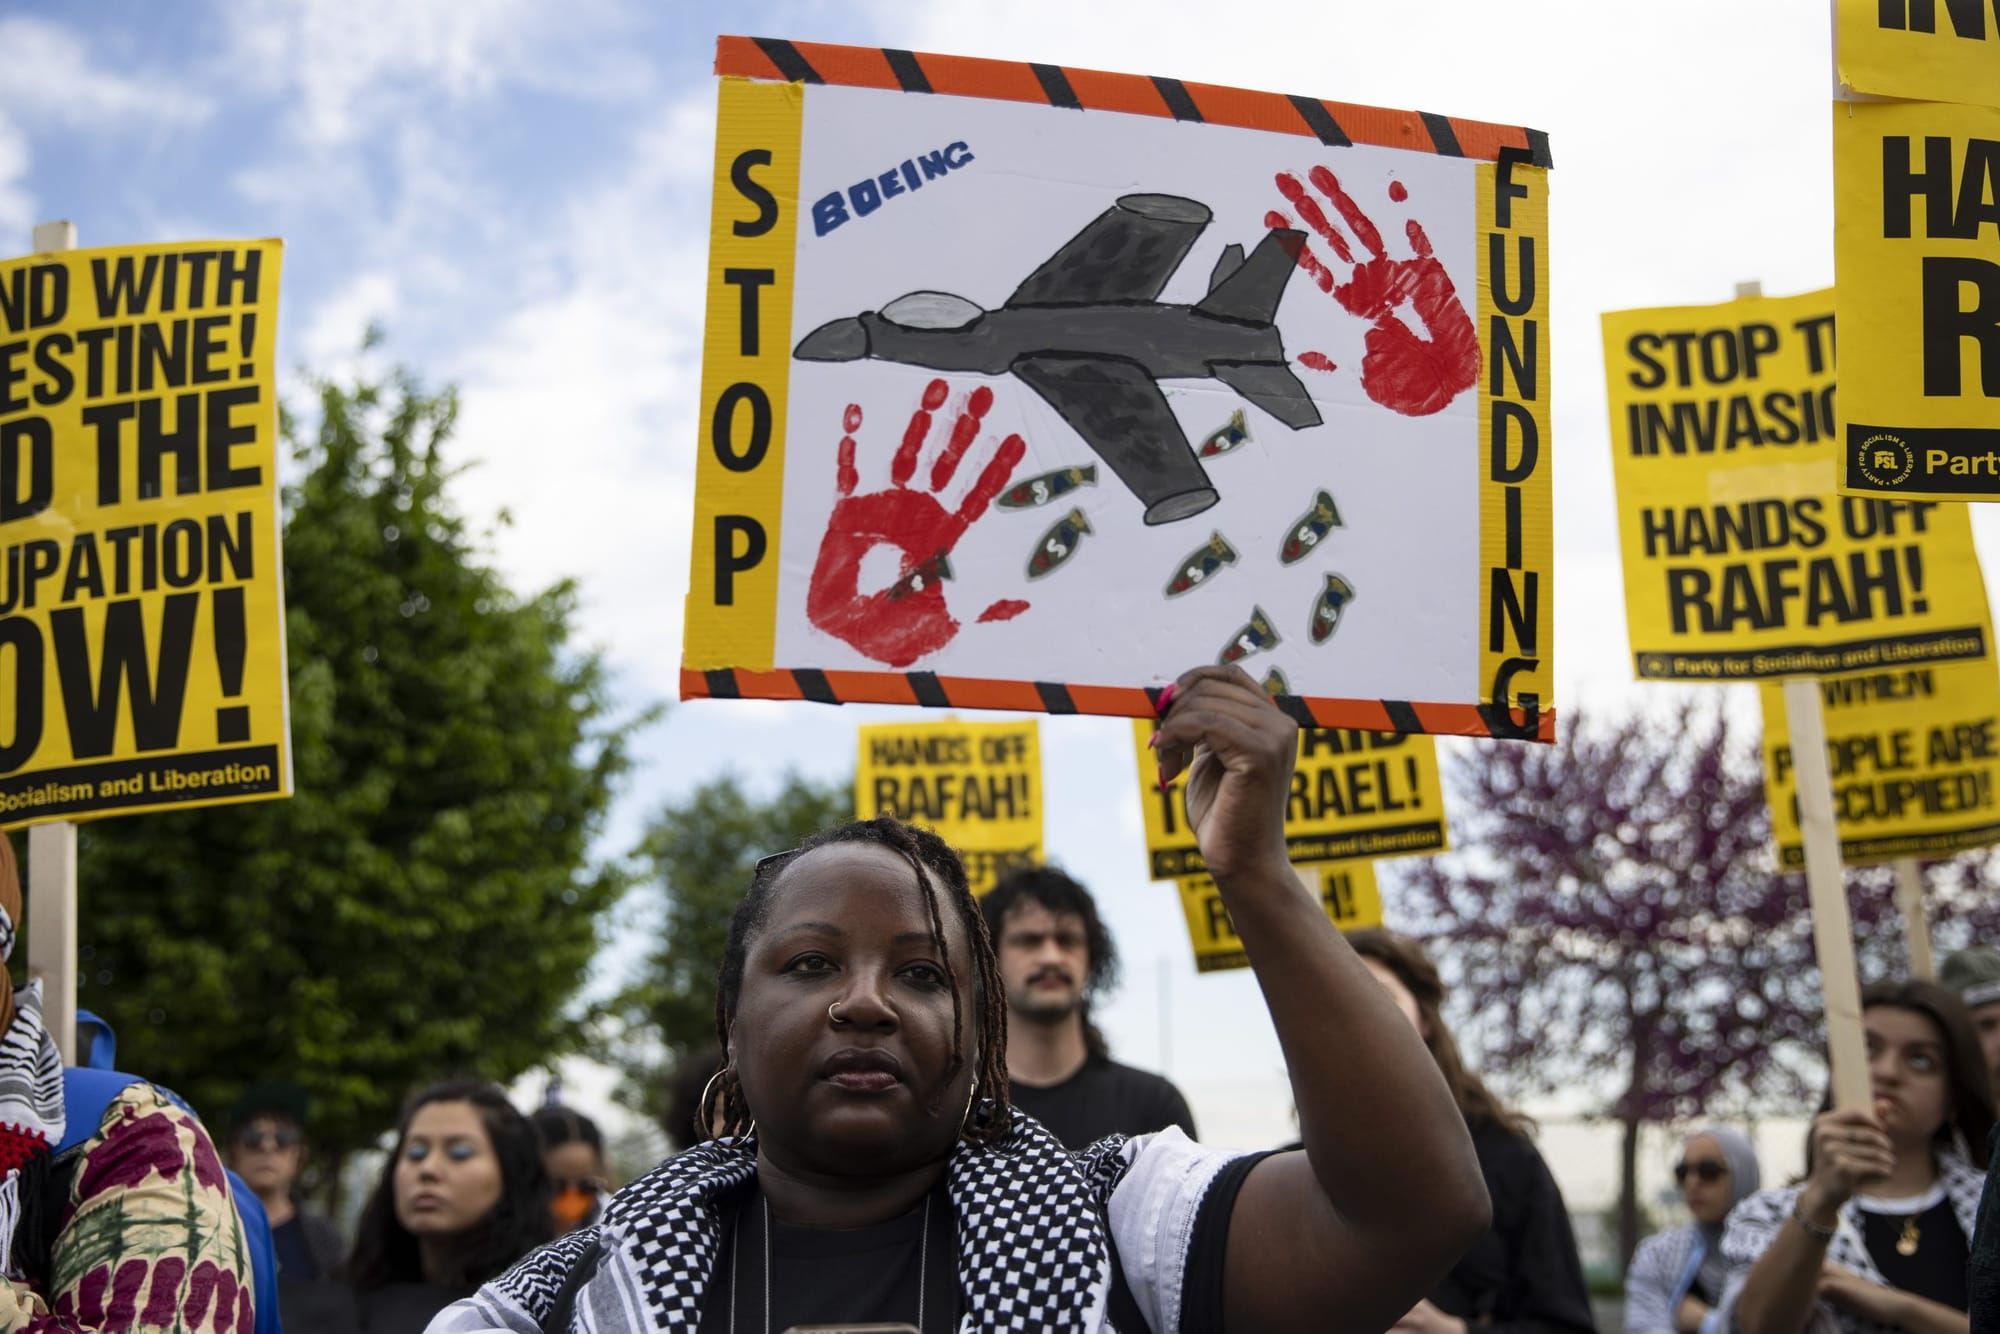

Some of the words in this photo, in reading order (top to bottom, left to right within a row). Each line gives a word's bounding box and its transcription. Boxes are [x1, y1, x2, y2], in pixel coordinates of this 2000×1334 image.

[812, 141, 975, 237] BOEING
[91, 250, 262, 319] WITH
[712, 149, 779, 606] STOP
[1627, 323, 1780, 389] STOP
[81, 386, 262, 507] THE
[1490, 146, 1540, 740] FUNDING
[1874, 456, 1898, 469] PSL
[1640, 498, 1827, 557] HANDS
[1666, 545, 1930, 635] RAFAH!
[870, 736, 971, 766] HANDS
[980, 734, 1026, 764] OFF
[1928, 717, 1998, 767] ARE
[99, 774, 143, 798] and
[150, 763, 270, 791] Liberation
[874, 773, 1030, 820] RAFAH!
